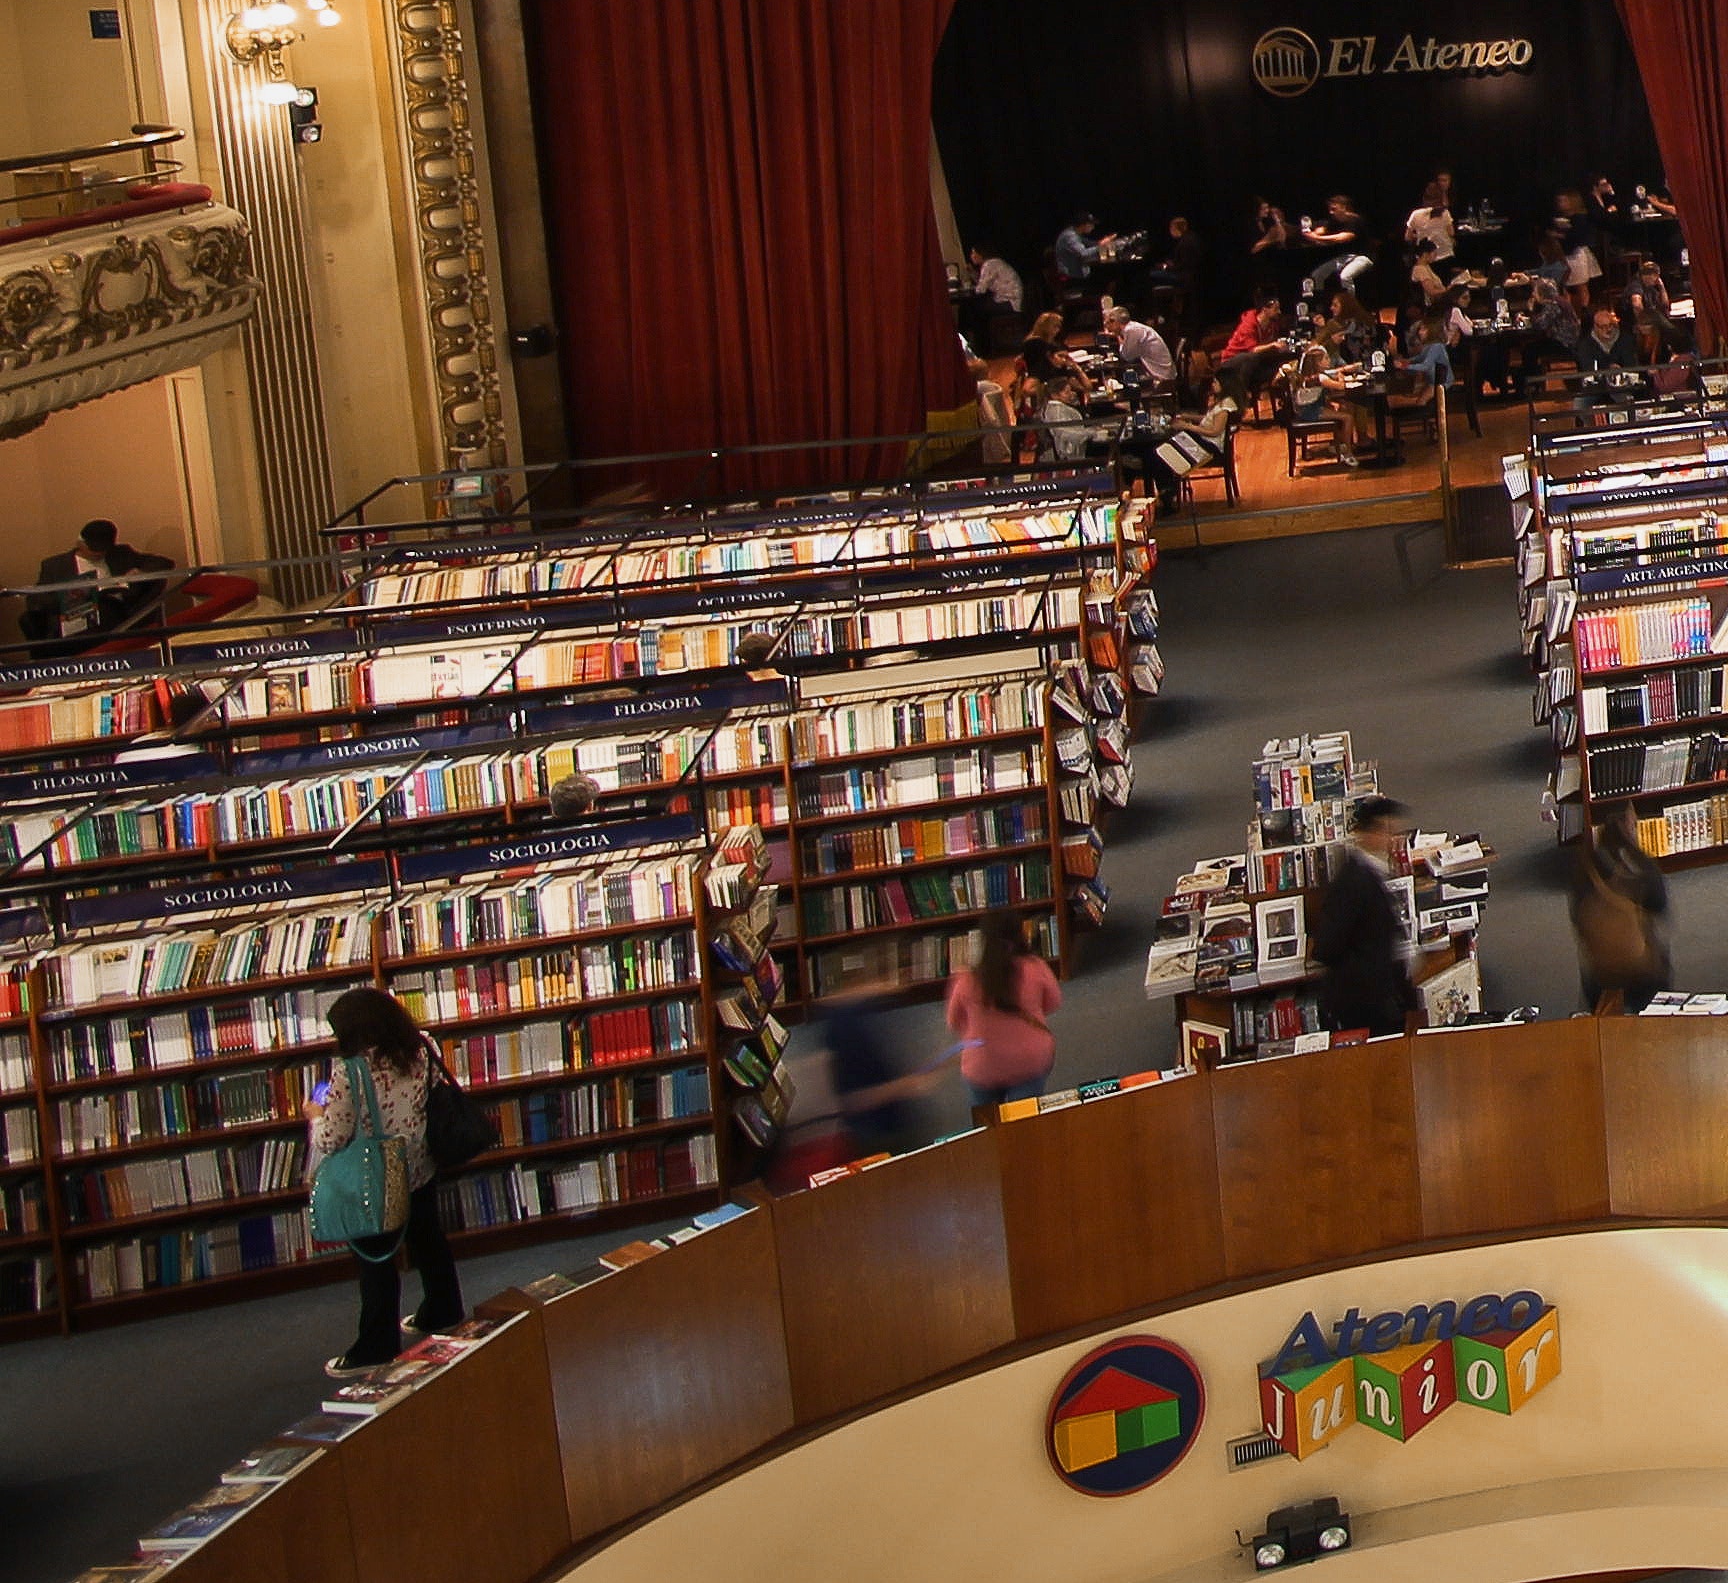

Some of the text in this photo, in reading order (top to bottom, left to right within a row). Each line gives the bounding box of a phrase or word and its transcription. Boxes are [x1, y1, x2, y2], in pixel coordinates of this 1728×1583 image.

[1323, 34, 1534, 78] El Ateneo
[1622, 569, 1657, 584] ARTE
[215, 640, 312, 660] MITOLOGIA
[0, 659, 132, 683] ANTROPOLOGIA
[614, 695, 702, 717] FILOSOFIA
[326, 736, 421, 760] FILOSOFIA
[32, 770, 130, 791] FILOSOFIA
[487, 833, 611, 863] SOCIOLOGIA
[163, 880, 294, 909] SOCIOLOGIA
[1263, 1288, 1545, 1378] Ateneo
[1266, 1328, 1562, 1441] Junior
